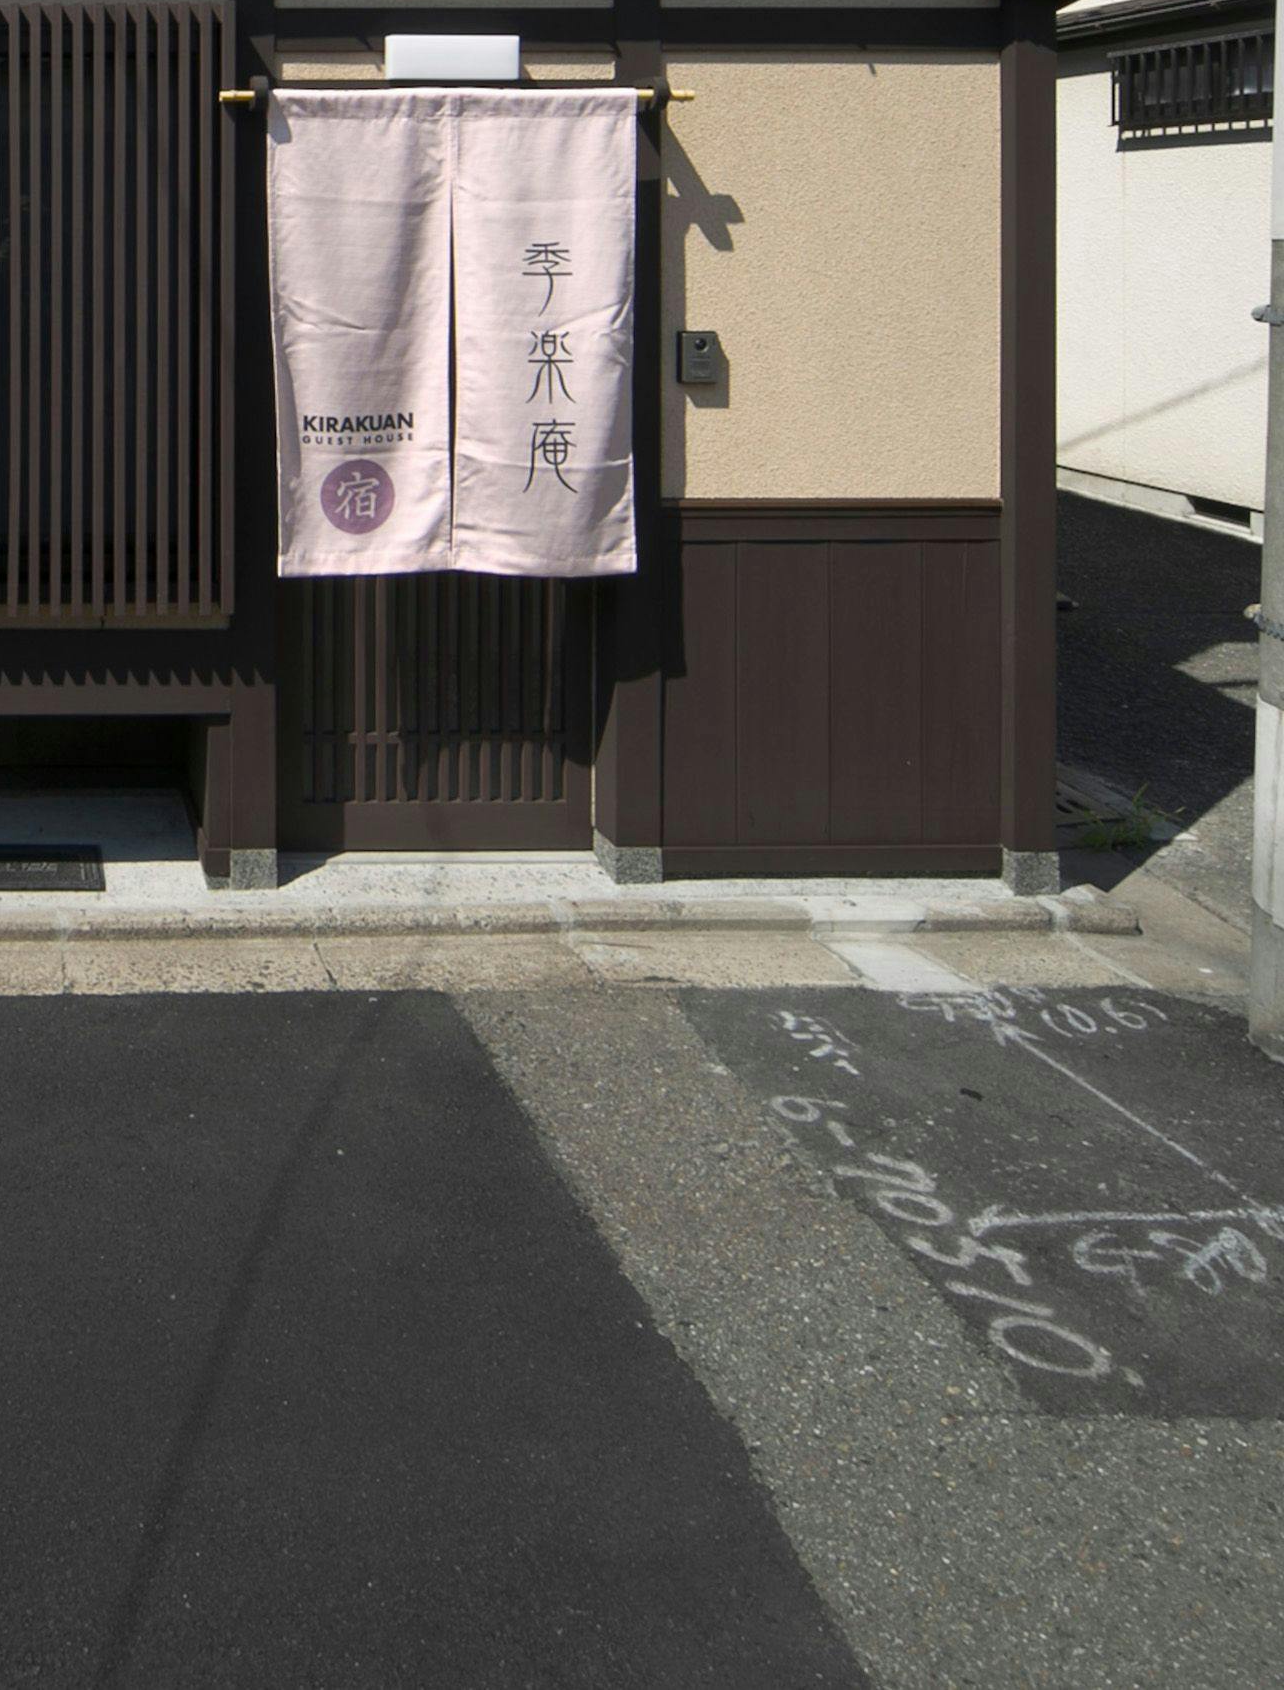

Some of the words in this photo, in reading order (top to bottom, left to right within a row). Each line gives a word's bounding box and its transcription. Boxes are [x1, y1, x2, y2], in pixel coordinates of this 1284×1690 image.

[521, 241, 578, 494] 季楽庵
[302, 435, 352, 445] GUEST
[363, 432, 413, 444] HOUSE
[303, 412, 414, 433] KIRAKUAN
[334, 471, 380, 520] 宿
